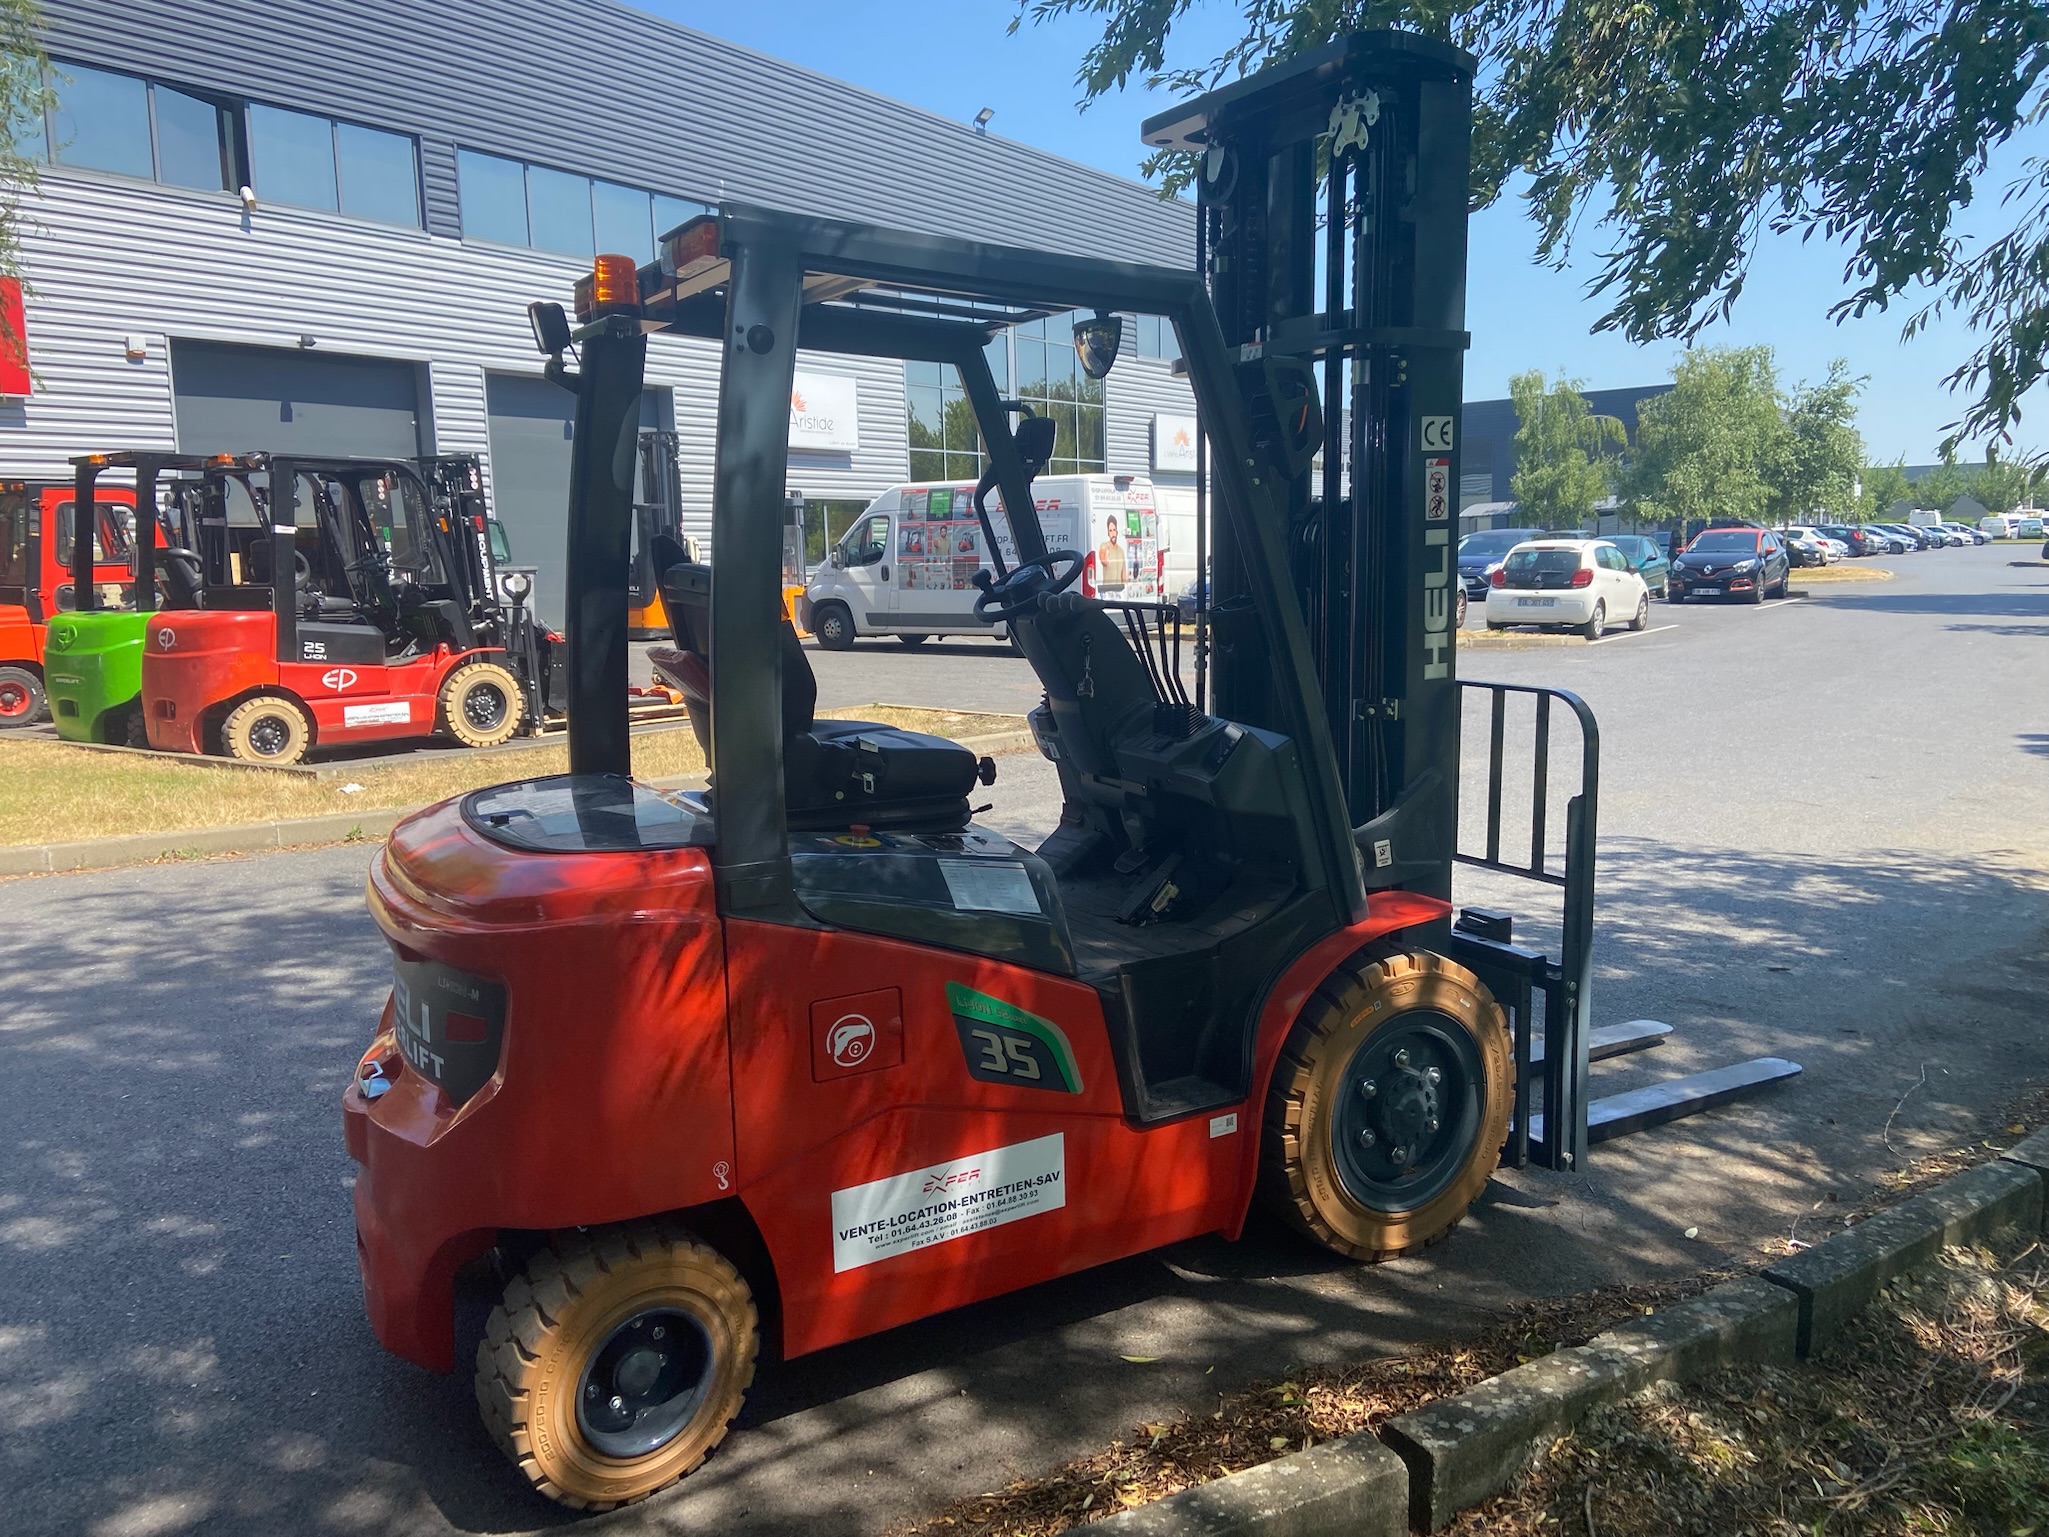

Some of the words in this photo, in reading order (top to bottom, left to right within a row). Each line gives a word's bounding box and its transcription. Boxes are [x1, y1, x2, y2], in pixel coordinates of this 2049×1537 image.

[789, 408, 834, 431] Aristide
[1424, 420, 1451, 446] CE
[1424, 528, 1449, 681] HELI
[158, 627, 176, 651] EP
[303, 641, 325, 653] 25
[321, 668, 358, 692] EP
[392, 973, 430, 1043] ELI
[971, 1029, 1041, 1079] 35
[922, 1165, 981, 1200] EXPER
[839, 1171, 1061, 1241] VENTE-LOCATION-ENTRETIEN-SAV
[868, 1234, 883, 1244] Tél
[891, 1212, 958, 1238] 01.64.43.26.08
[966, 1206, 980, 1216] Fax
[911, 1239, 924, 1248] Fax
